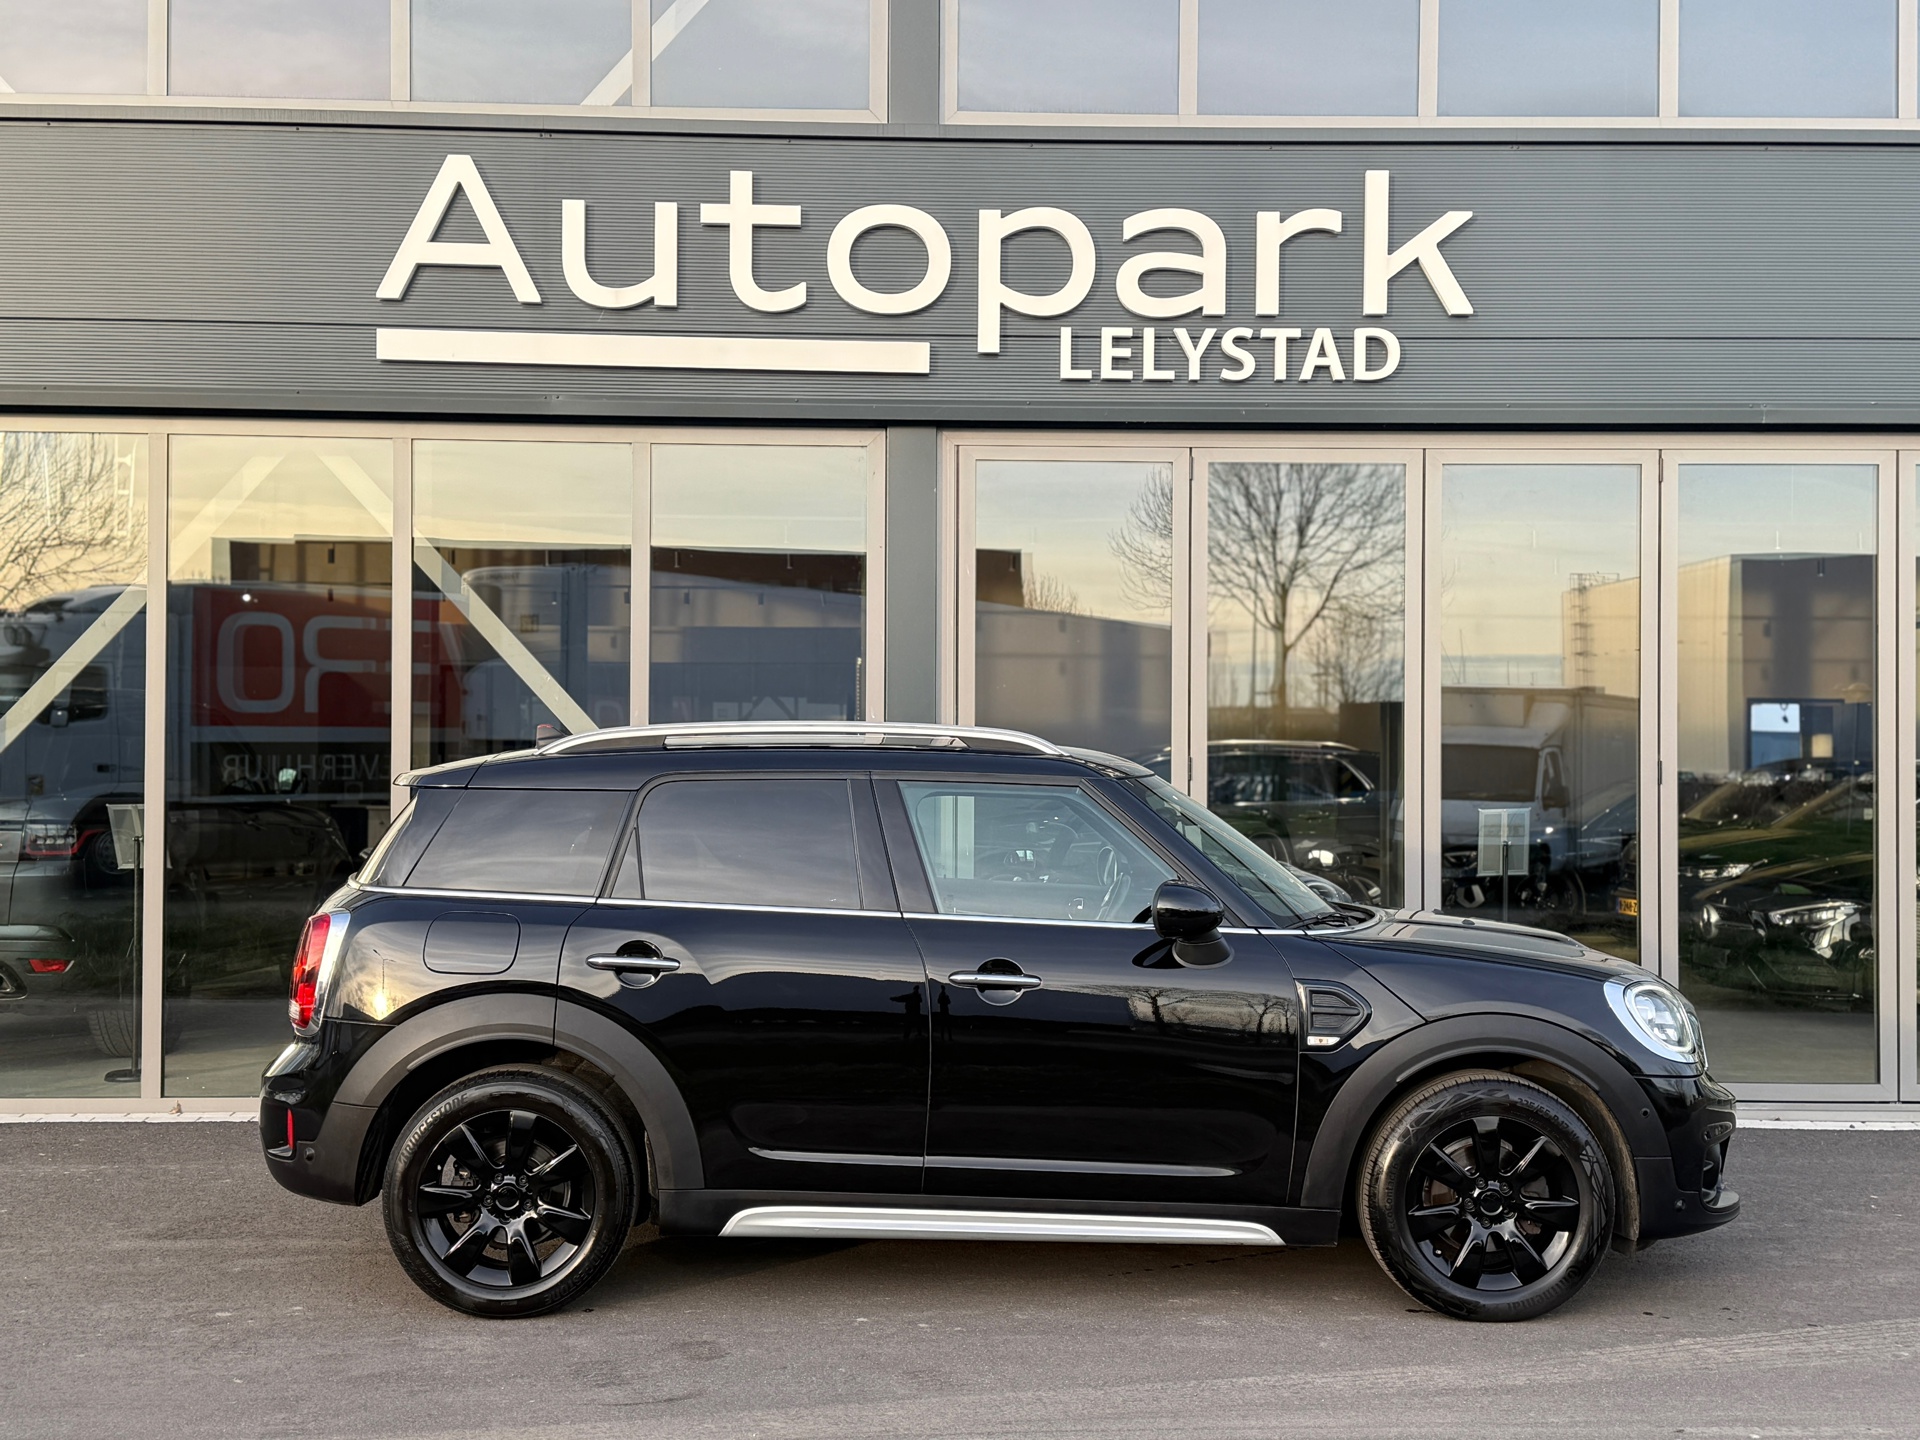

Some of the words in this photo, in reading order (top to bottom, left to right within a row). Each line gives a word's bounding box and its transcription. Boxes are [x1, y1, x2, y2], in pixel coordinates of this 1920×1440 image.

[375, 153, 1475, 355] Autopark
[1059, 326, 1402, 383] LELYSTAD
[397, 1092, 469, 1167] BRIDGESTONE
[1506, 1265, 1581, 1312] Continental
